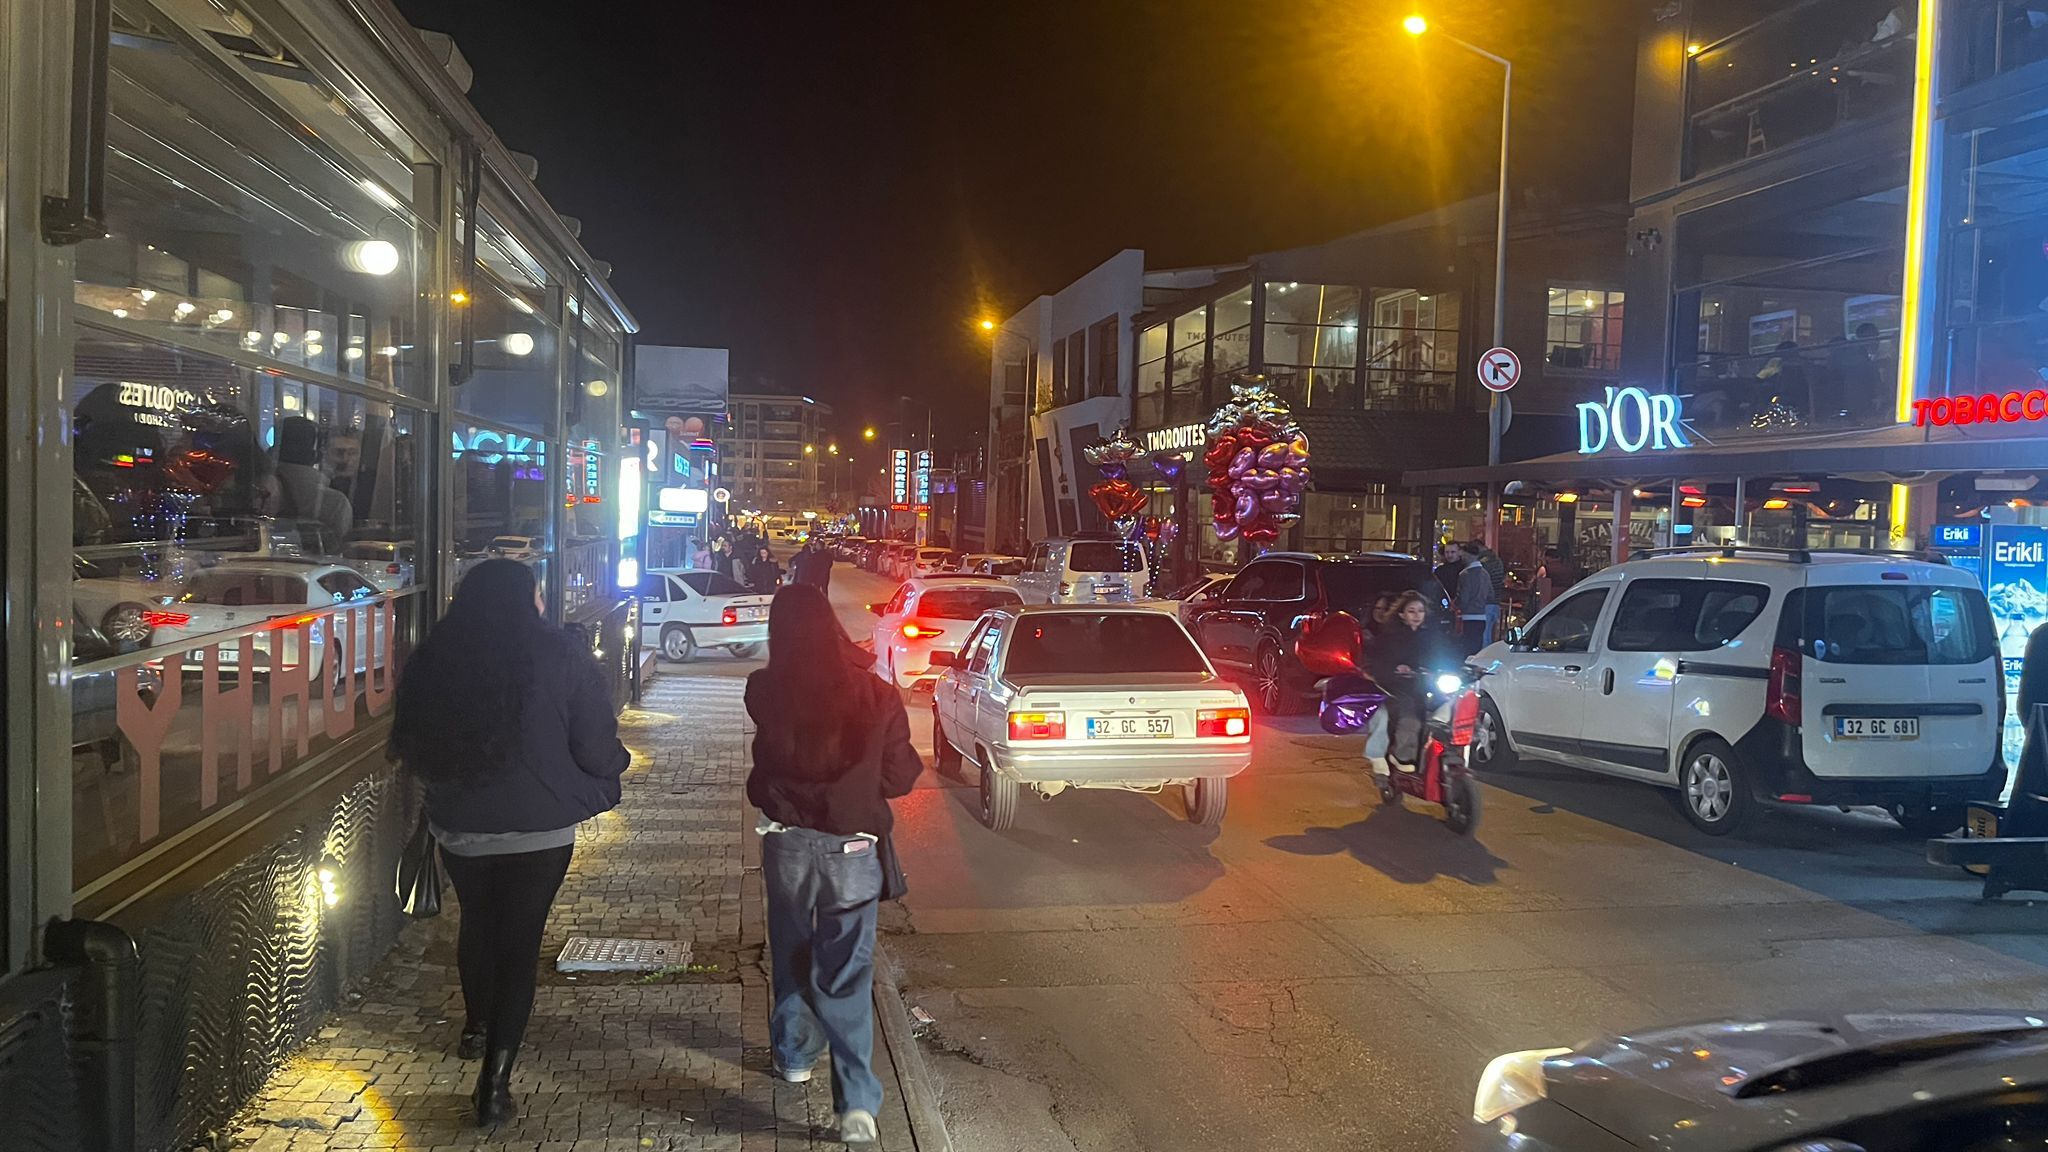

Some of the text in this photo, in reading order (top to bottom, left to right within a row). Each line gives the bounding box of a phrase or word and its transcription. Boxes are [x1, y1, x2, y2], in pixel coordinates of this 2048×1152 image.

[1912, 389, 2048, 428] TOBACC
[1575, 385, 1690, 454] D'OR
[1147, 423, 1206, 452] TWOROUTES
[1943, 527, 1969, 540] Erikli
[1995, 541, 2043, 562] Erikli
[2003, 659, 2023, 671] Erik
[1095, 719, 1170, 734] 32 GC 557
[1847, 720, 1863, 734] 32
[1870, 720, 1887, 734] GC
